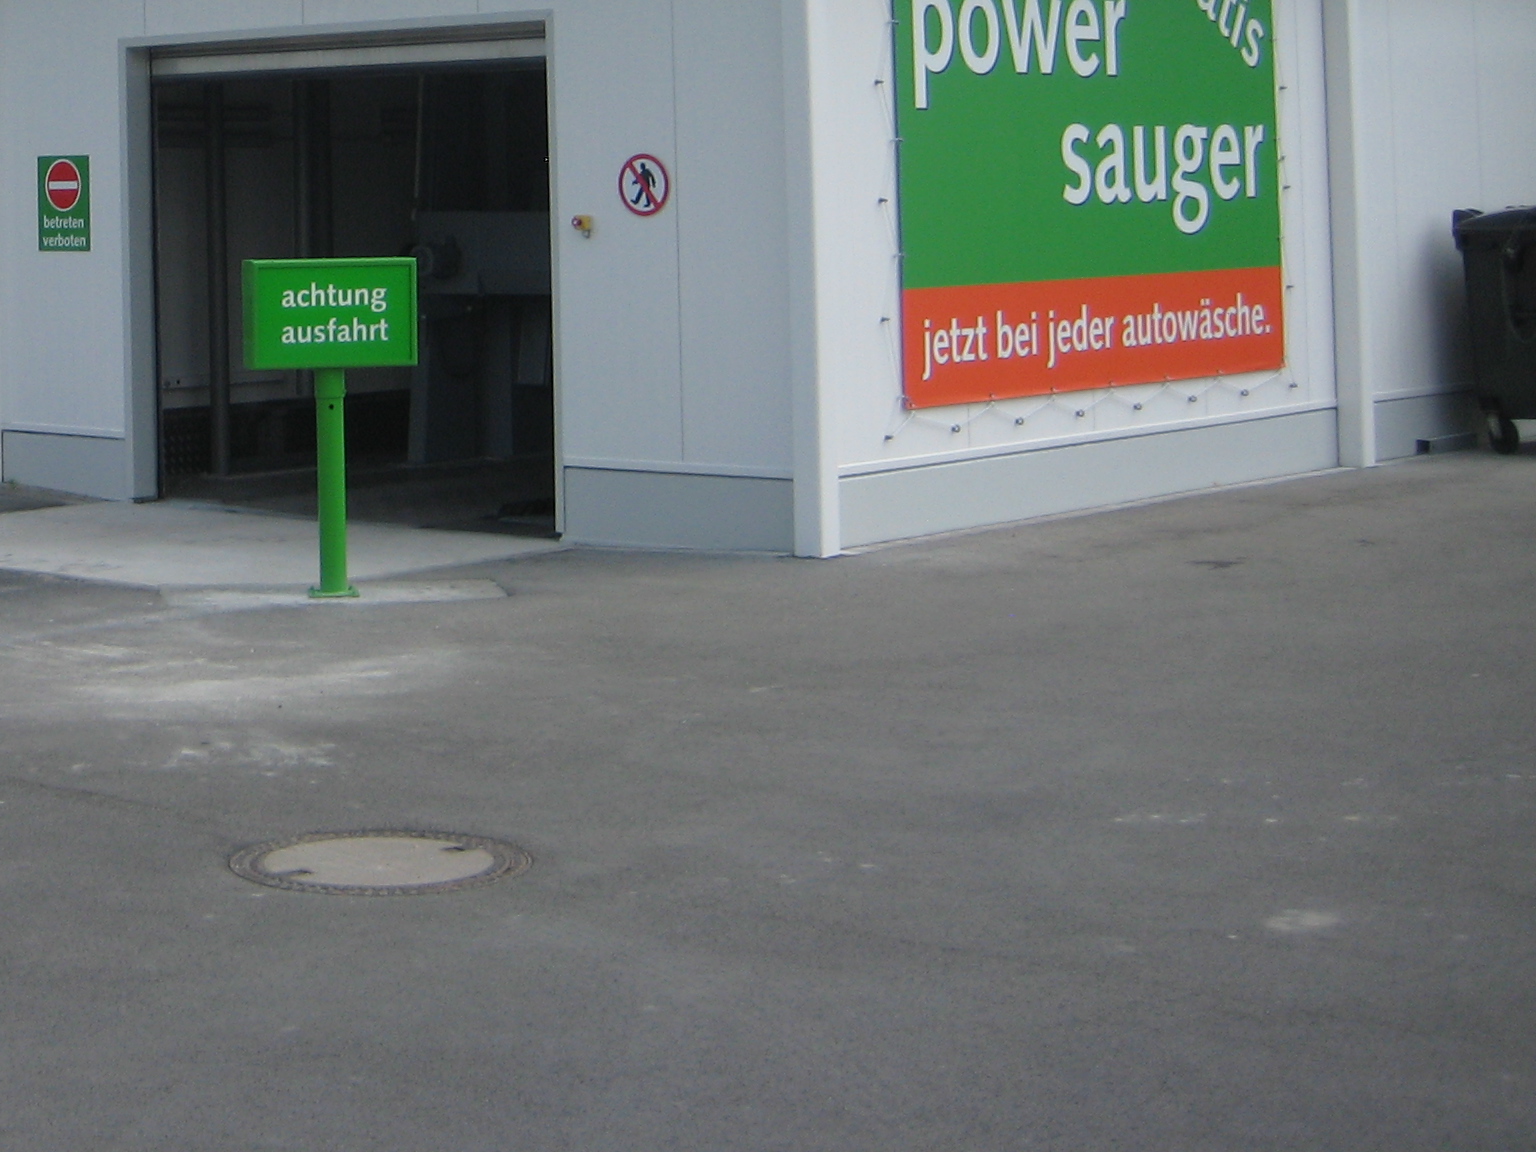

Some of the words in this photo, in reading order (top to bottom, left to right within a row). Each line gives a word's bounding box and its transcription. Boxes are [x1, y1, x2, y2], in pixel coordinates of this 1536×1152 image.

[1061, 123, 1264, 234] sauger
[43, 215, 84, 229] betreten
[42, 233, 86, 247] verboten
[281, 282, 387, 313] achtung
[281, 317, 389, 344] ausfahrt
[922, 316, 988, 381] jetzt
[996, 310, 1038, 359] bei
[1047, 304, 1115, 369] jeder
[1122, 292, 1271, 347] autowäsche.
